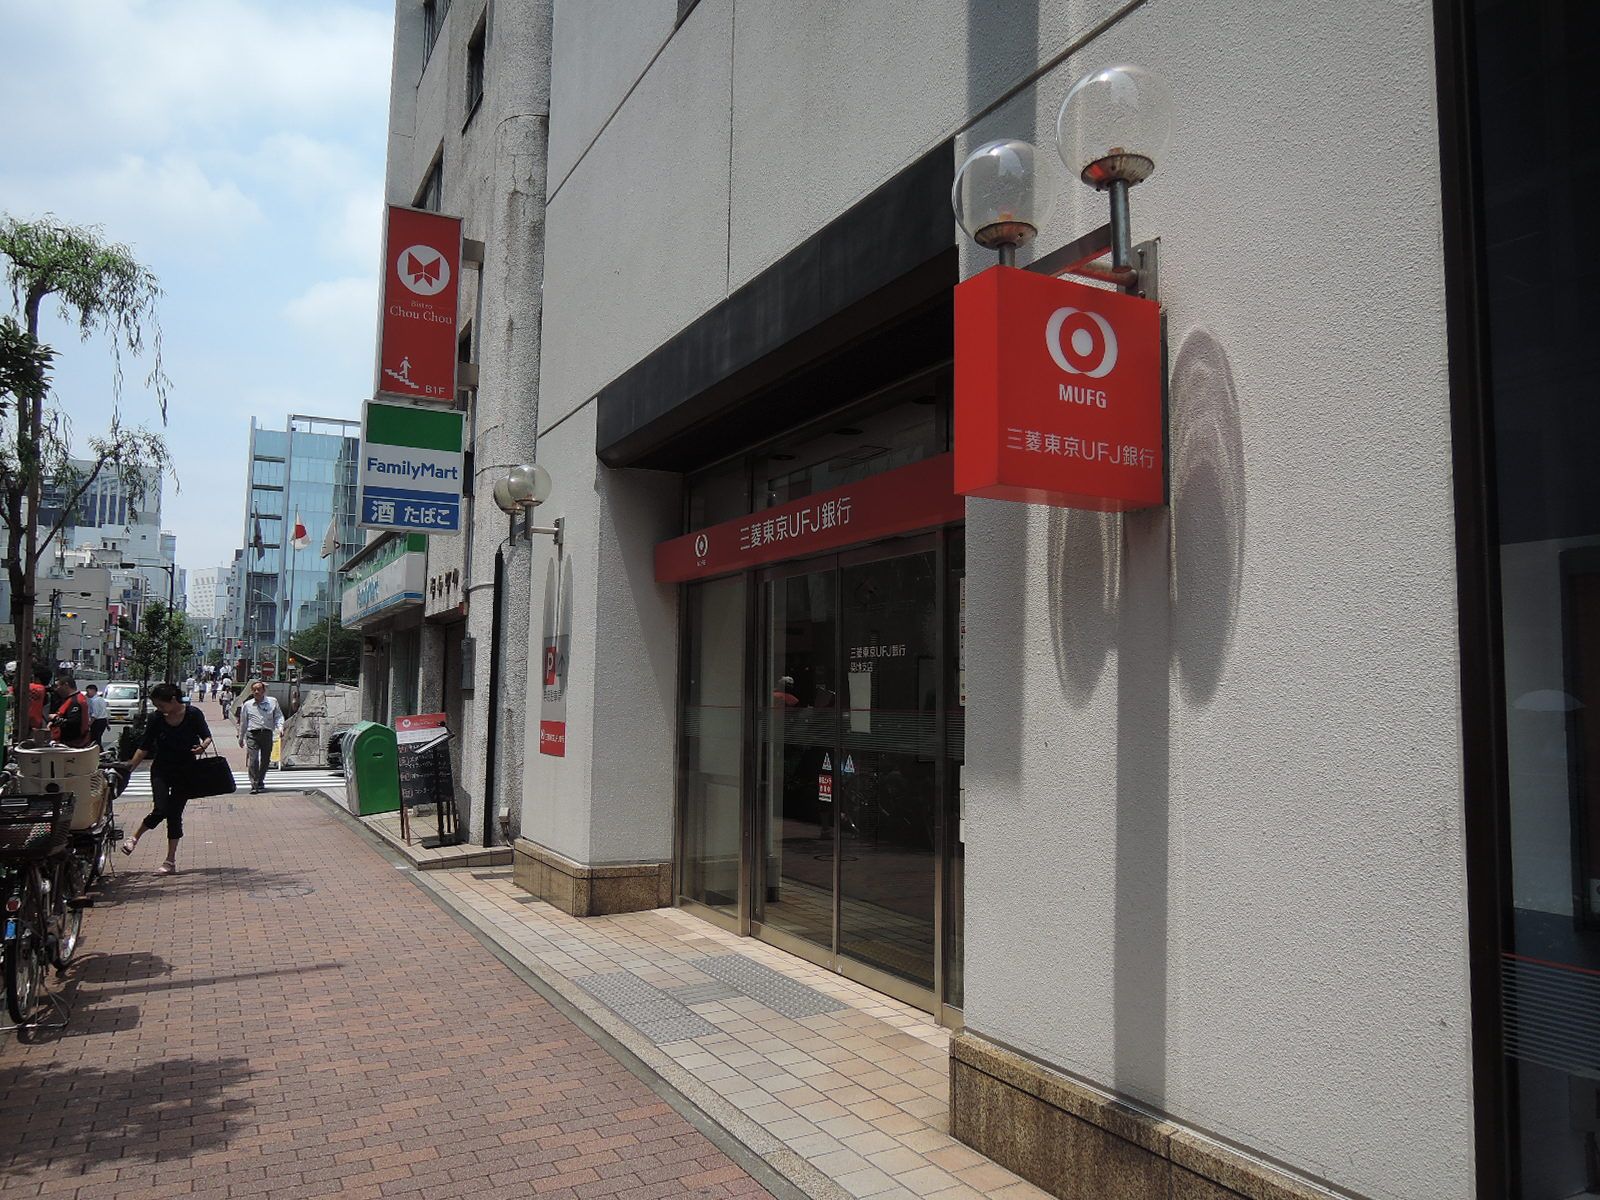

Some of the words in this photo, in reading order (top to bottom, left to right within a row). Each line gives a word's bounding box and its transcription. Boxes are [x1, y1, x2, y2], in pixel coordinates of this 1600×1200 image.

[390, 305, 419, 319] Chou
[423, 311, 452, 325] Chou
[425, 384, 446, 395] B1F
[1058, 384, 1108, 409] MUFG
[1007, 427, 1155, 469] 三菱東京UFJ銀行
[367, 457, 458, 480] FamilyMart
[371, 501, 396, 524] 酒
[404, 506, 450, 525] たばこ
[739, 496, 852, 551] 三菱東京UFJ銀行
